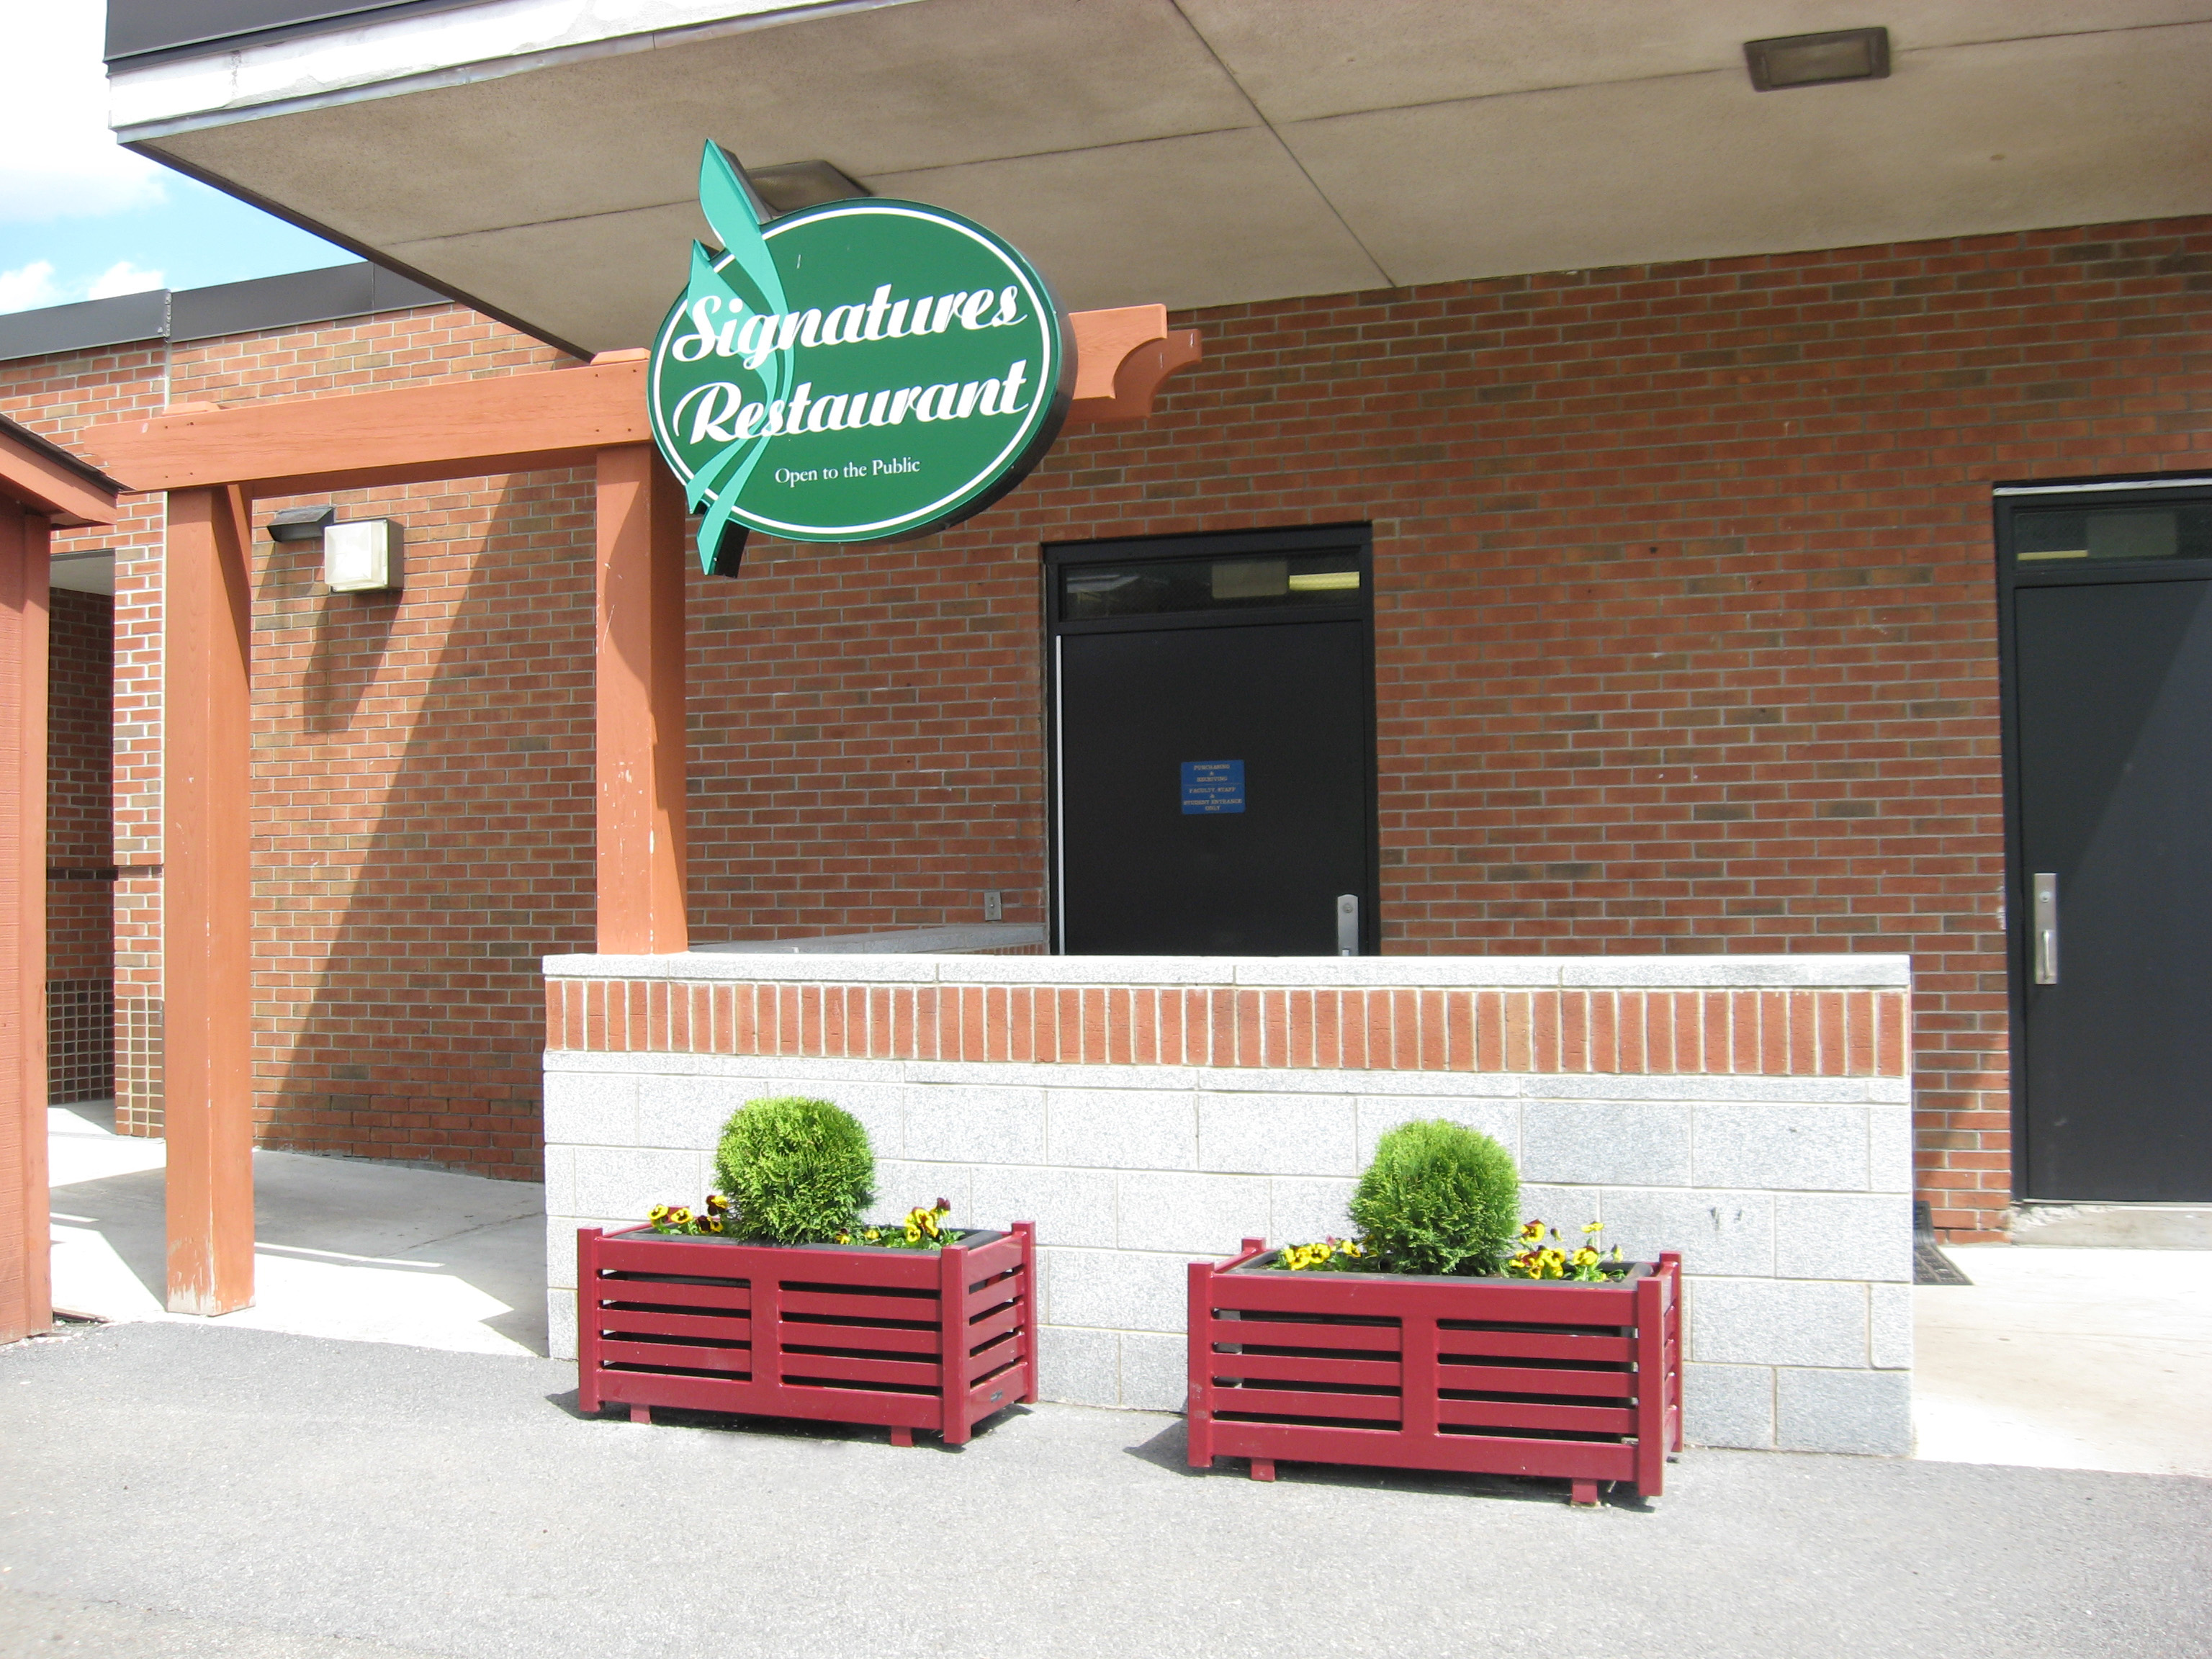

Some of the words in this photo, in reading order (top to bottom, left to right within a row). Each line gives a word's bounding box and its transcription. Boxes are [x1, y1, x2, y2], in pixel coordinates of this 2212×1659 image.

[671, 284, 1028, 369] Signatures
[672, 359, 1029, 444] Restaurant
[775, 467, 818, 488] Open
[823, 467, 839, 480] to
[843, 462, 868, 478] the
[872, 457, 921, 476] Public
